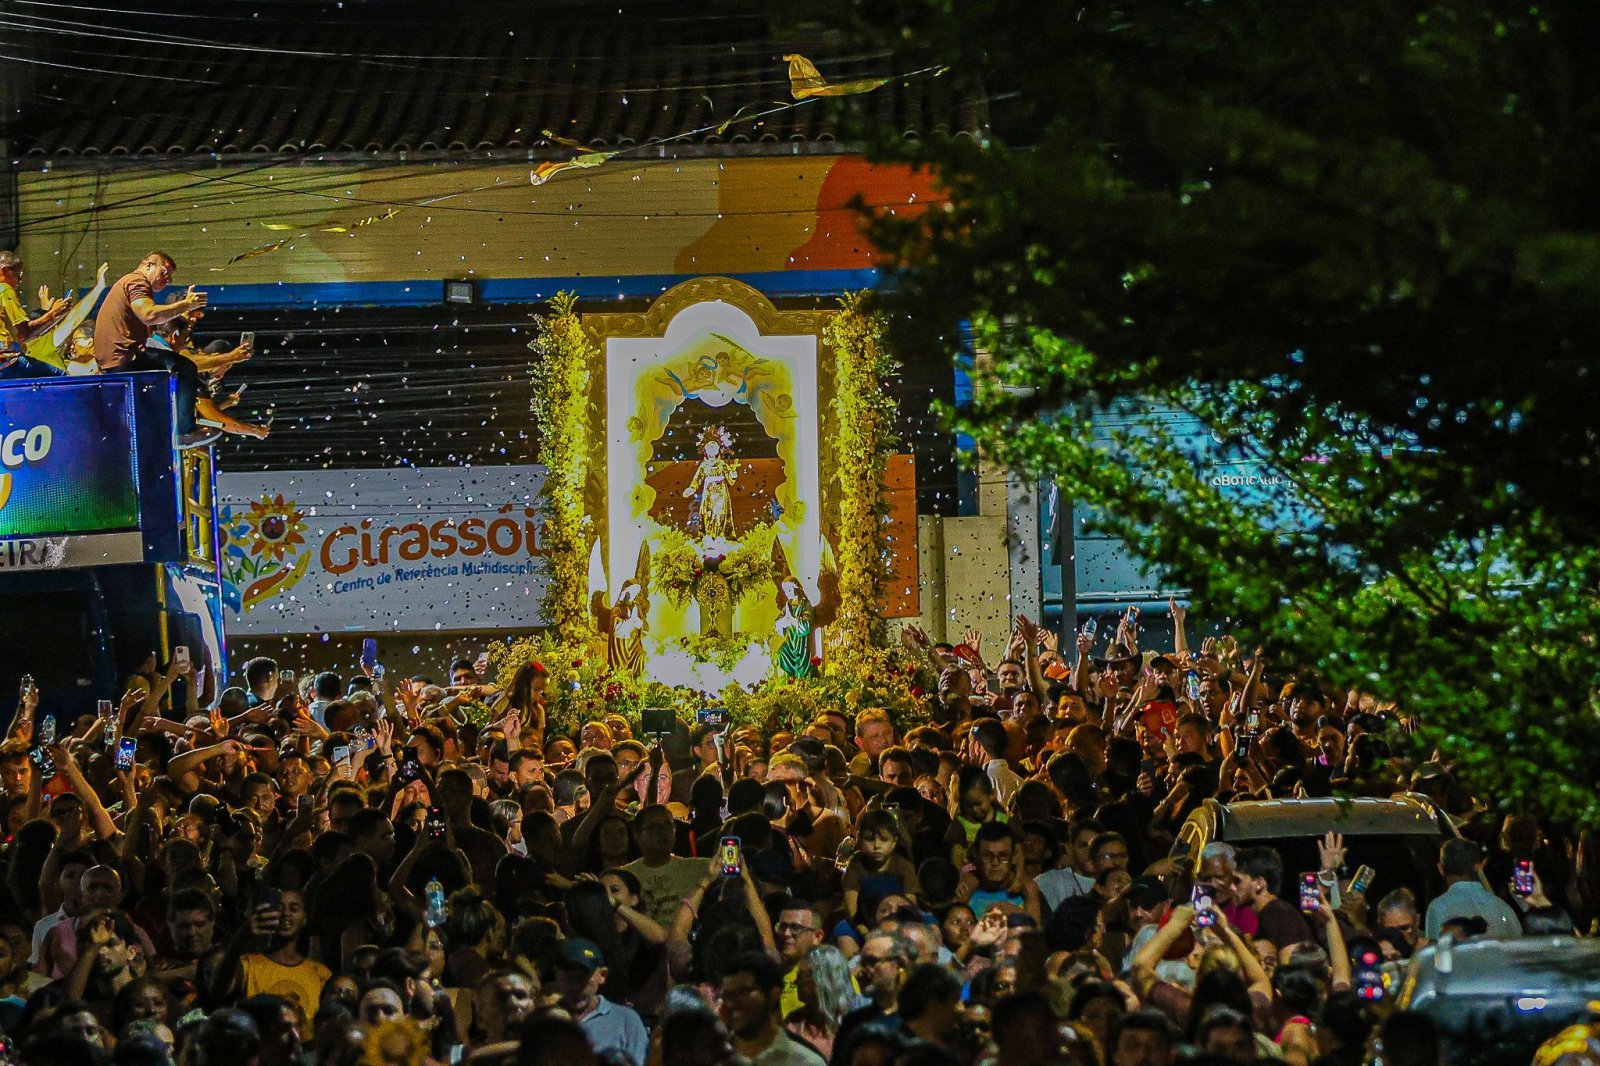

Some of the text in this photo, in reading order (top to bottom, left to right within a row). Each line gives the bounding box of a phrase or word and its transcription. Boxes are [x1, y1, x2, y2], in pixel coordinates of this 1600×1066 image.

[333, 561, 540, 594] Centro de Referência Multidiscipli
